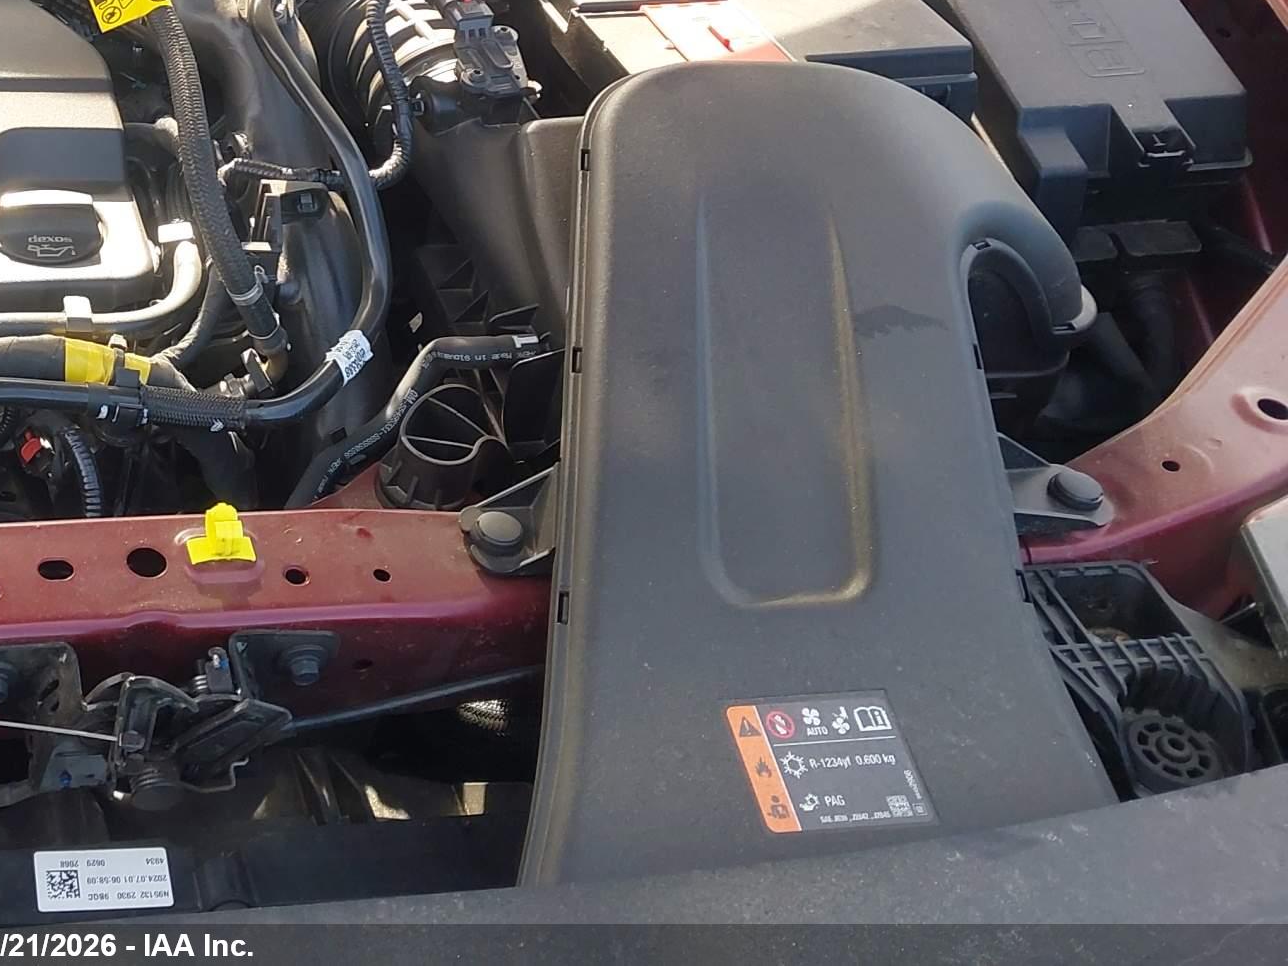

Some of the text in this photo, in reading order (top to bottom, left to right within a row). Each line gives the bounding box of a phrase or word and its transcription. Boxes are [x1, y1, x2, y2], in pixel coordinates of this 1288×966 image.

[28, 235, 73, 243] dexos
[807, 726, 828, 737] AUTO
[809, 754, 896, 769] R-1234yf 0.600 kg
[824, 795, 846, 807] PAG
